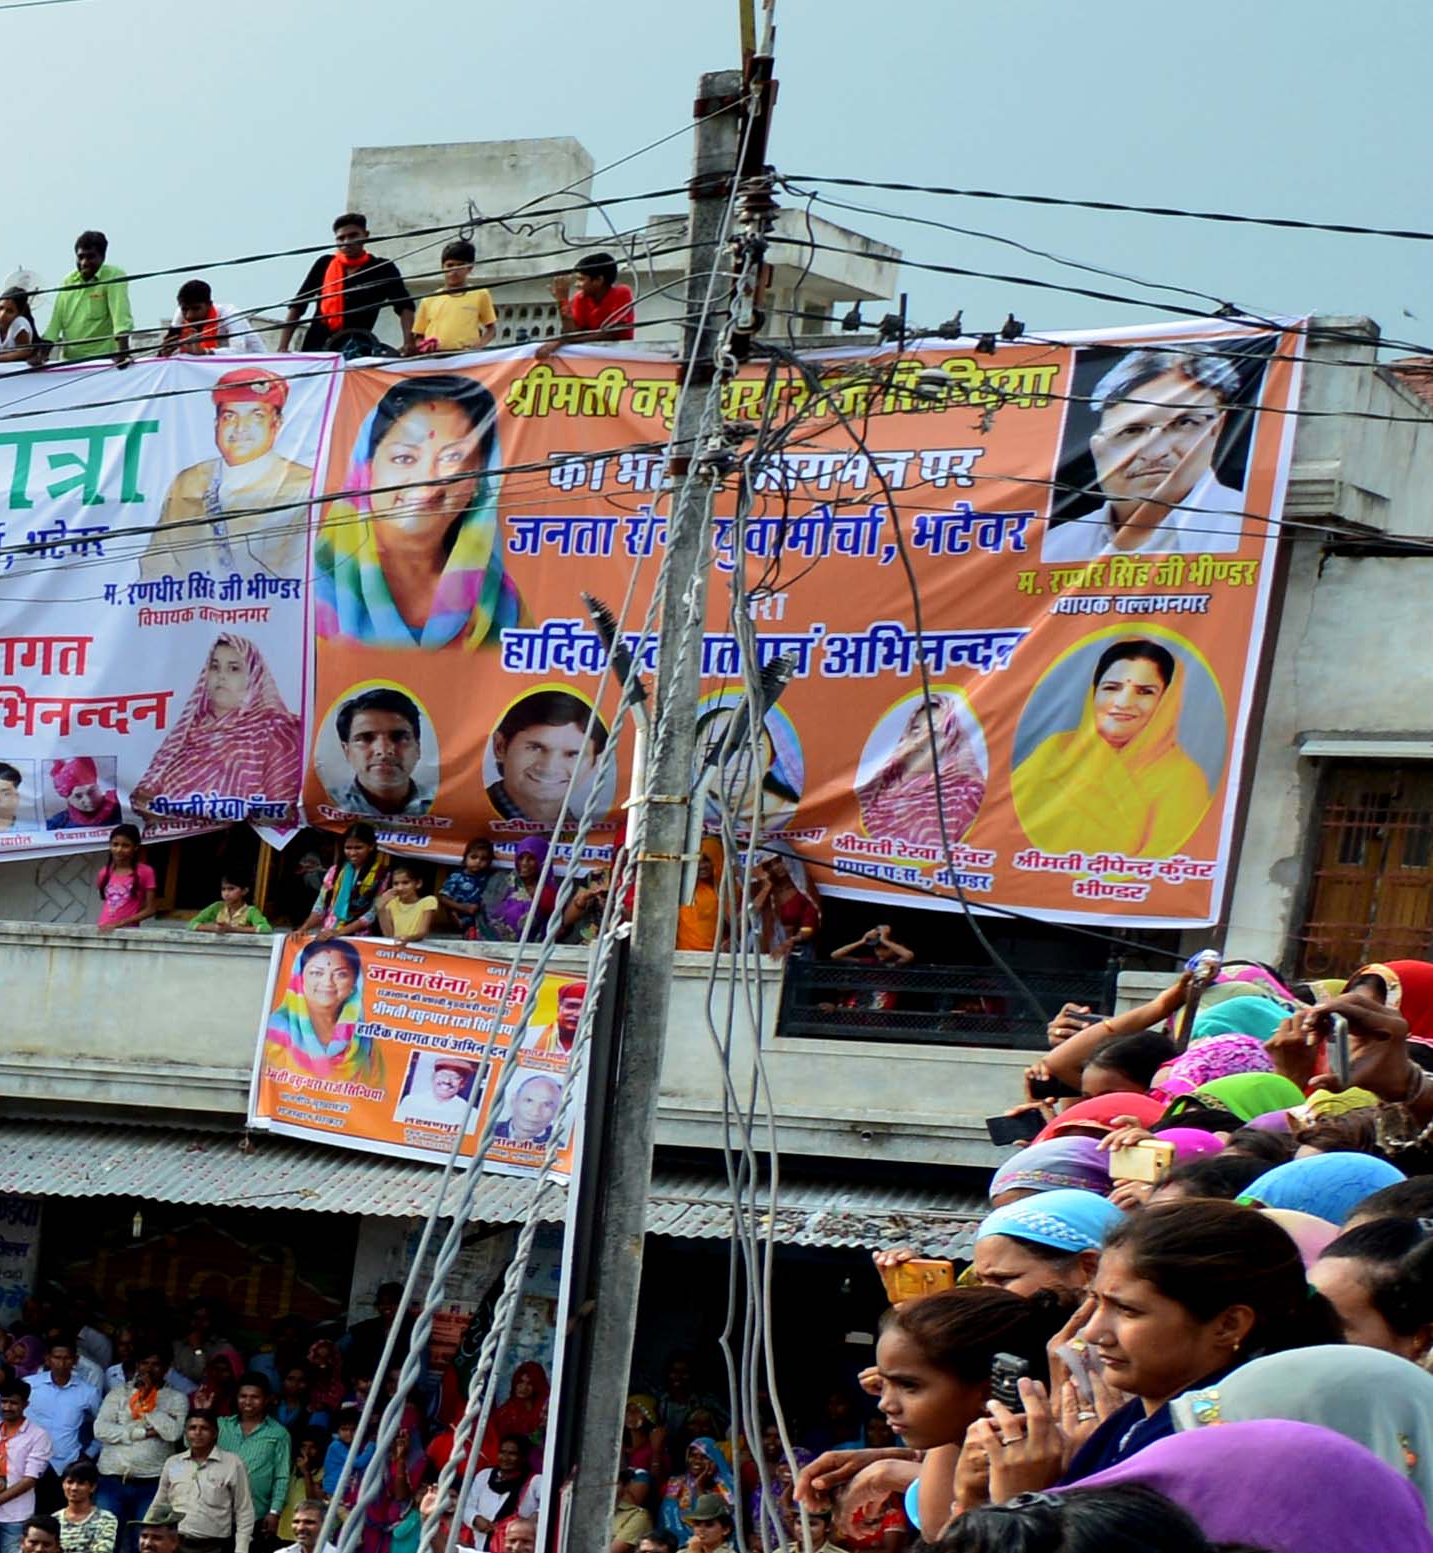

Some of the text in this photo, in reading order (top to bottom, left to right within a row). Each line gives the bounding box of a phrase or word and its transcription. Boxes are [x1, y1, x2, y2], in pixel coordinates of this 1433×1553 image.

[505, 363, 629, 418] श्रीमती
[917, 446, 985, 490] पर
[507, 514, 621, 558] जनता
[911, 502, 1039, 556] भटेवर
[1155, 557, 1185, 588] जी
[1189, 553, 1260, 587] भीण्डर
[127, 574, 184, 605] रणधीर
[218, 573, 242, 601] जी
[247, 572, 302, 600] भीण्डर
[1116, 594, 1211, 615] वल्लभनगर
[138, 606, 195, 628] विधायक
[502, 619, 609, 675] हार्दिक
[833, 833, 893, 862] श्रीमती
[896, 838, 940, 864] रेखा
[1013, 851, 1083, 875] श्रीमती
[1086, 854, 1153, 881] दीपेन्द्र
[1074, 880, 1148, 901] भीण्डर
[368, 964, 426, 989] जनता
[427, 969, 469, 995] सेना
